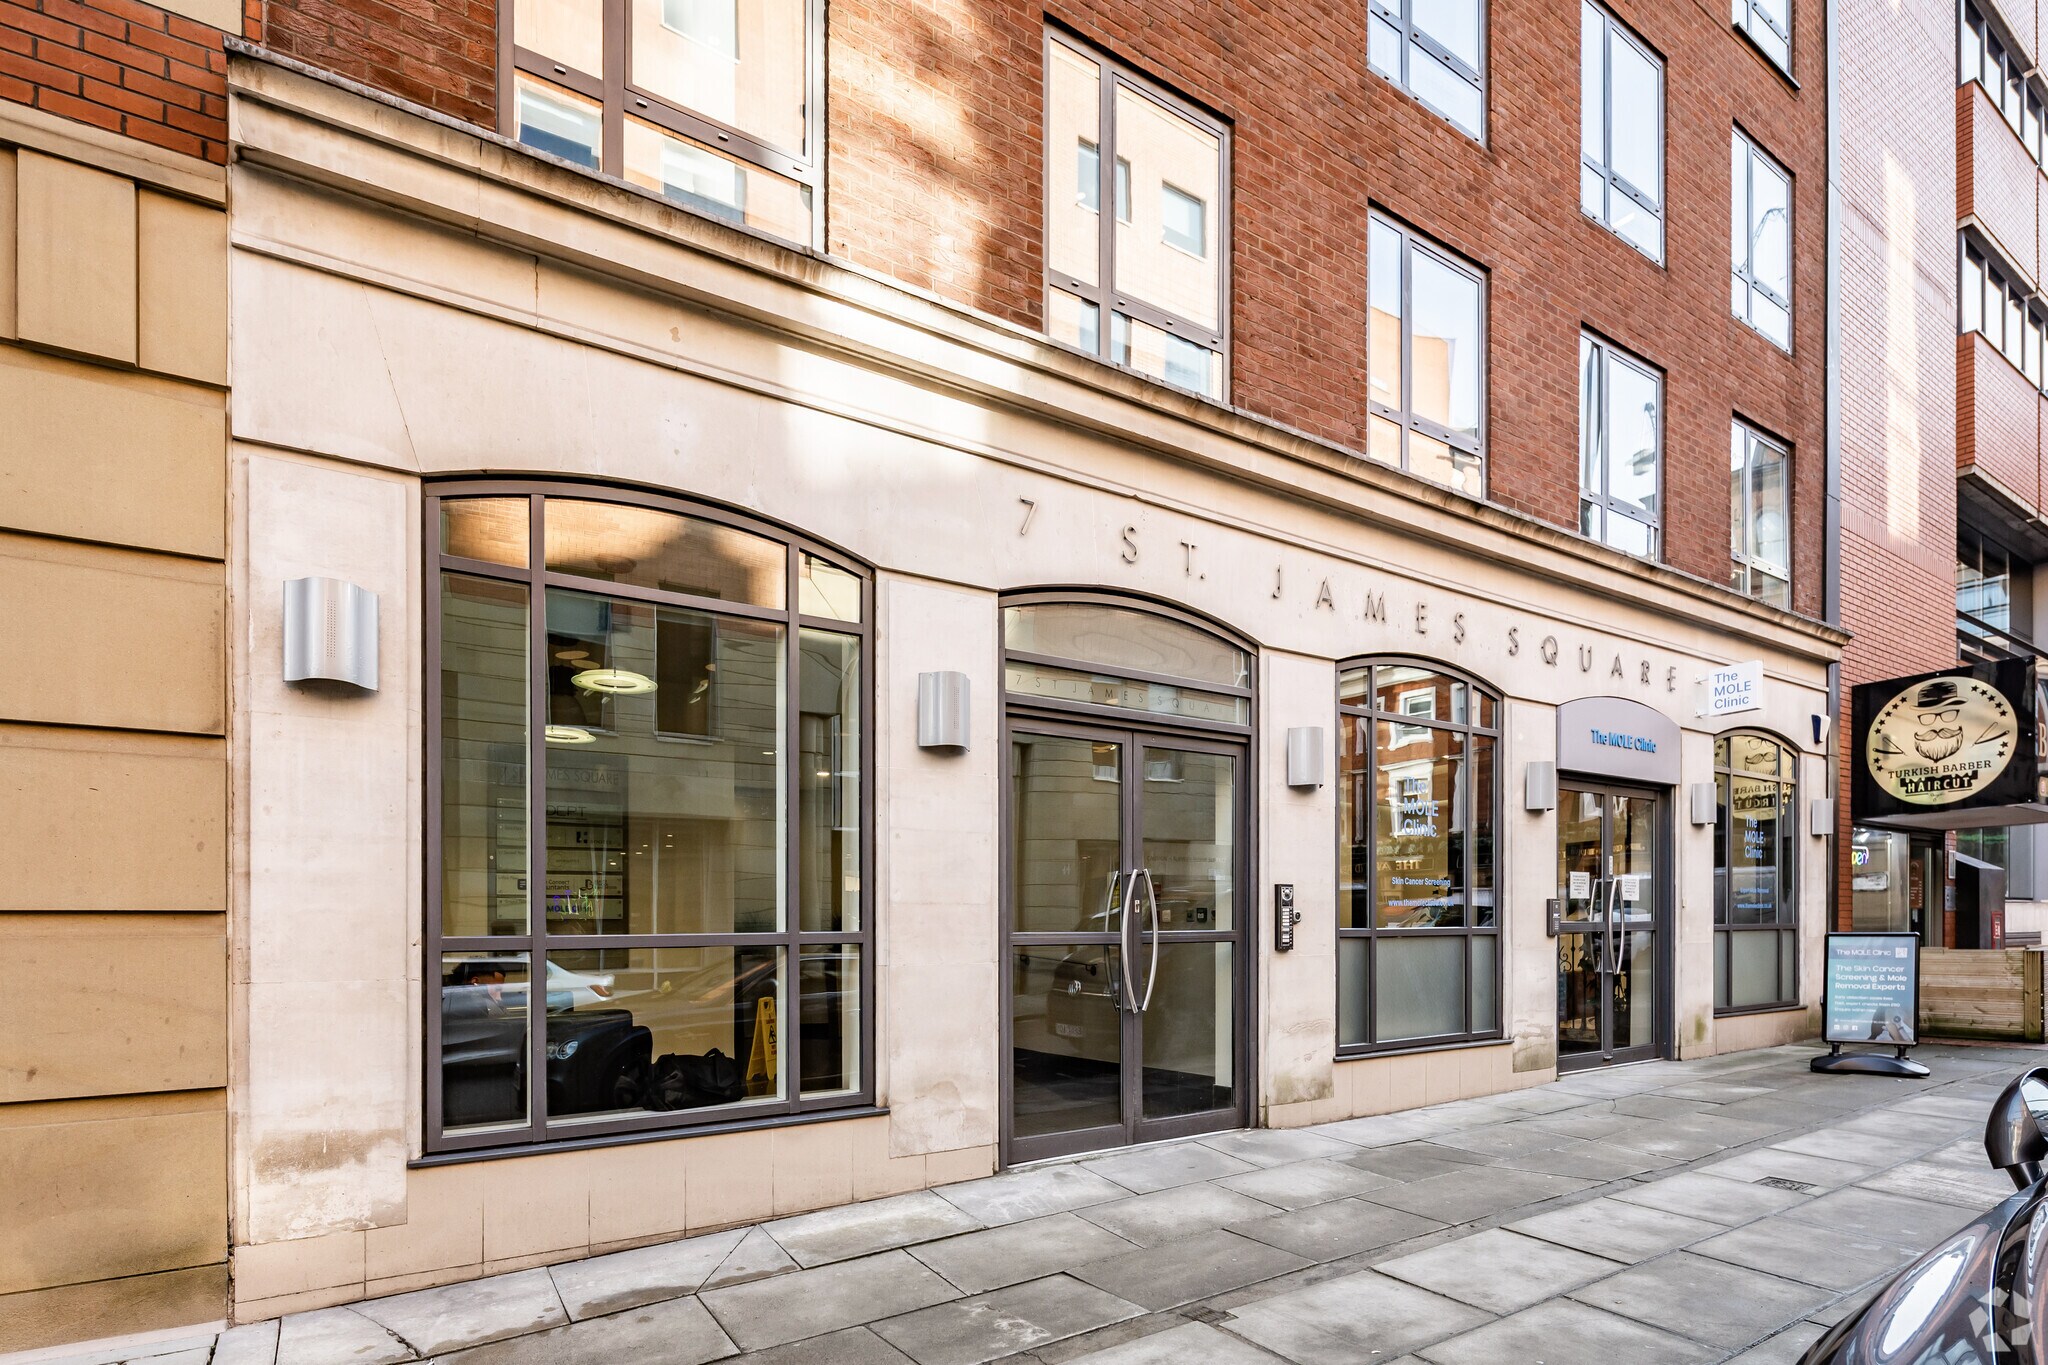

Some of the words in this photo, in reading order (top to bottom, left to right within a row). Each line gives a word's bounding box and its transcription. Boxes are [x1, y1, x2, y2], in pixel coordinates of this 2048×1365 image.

[1017, 494, 1039, 537] 7
[1121, 523, 1207, 580] ST.
[1272, 563, 1466, 645] JAMES
[1507, 625, 1678, 693] SQUARE
[1714, 672, 1738, 684] The
[1714, 680, 1752, 697] MOLE
[1714, 694, 1750, 709] Clinic
[1590, 728, 1608, 746] The
[1608, 731, 1633, 750] MOLE
[1634, 736, 1657, 753] Clinic
[1887, 765, 1939, 779] TURKISH
[1942, 759, 1992, 773] BARBER
[1403, 776, 1427, 794] The
[1907, 776, 1970, 793] HAIRCUT
[1403, 797, 1439, 817] MOLE
[1403, 818, 1437, 837] Clinic
[1745, 814, 1758, 828] The
[1744, 830, 1764, 844] MOLE
[1744, 845, 1763, 859] Clinic
[1391, 876, 1404, 885] Skin
[1404, 877, 1424, 886] Cancer
[1424, 877, 1451, 888] Screening
[1835, 973, 1878, 983] Screening
[1887, 974, 1907, 982] Mole
[1835, 982, 1871, 990] Removal
[1872, 983, 1906, 991] Experts
